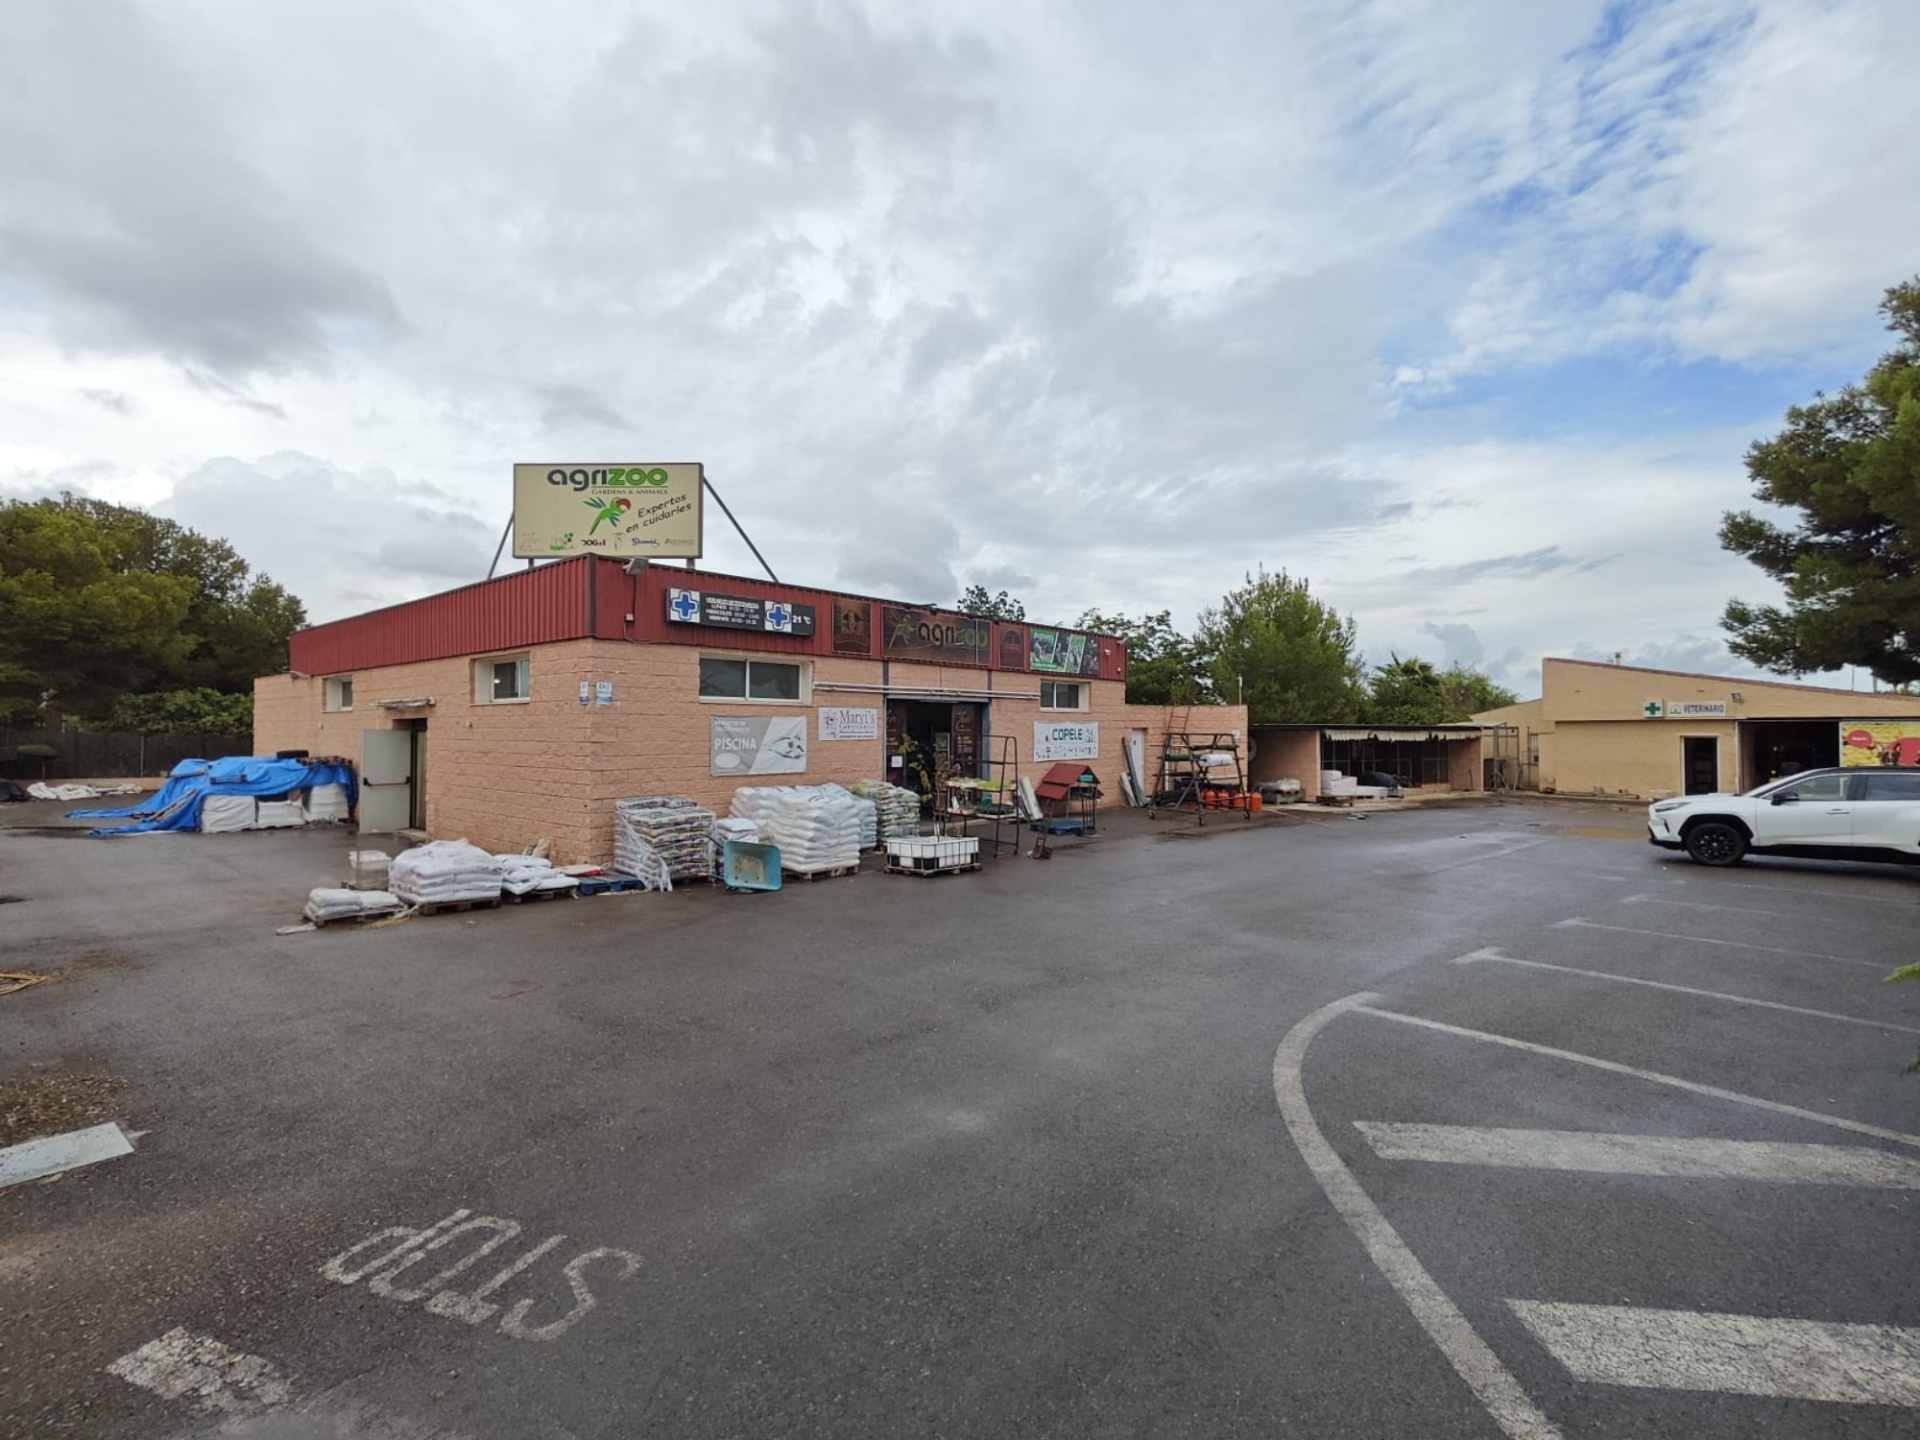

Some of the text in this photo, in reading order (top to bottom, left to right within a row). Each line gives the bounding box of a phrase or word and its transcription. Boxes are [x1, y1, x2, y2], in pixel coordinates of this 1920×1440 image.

[547, 468, 668, 491] agrizoo
[638, 494, 687, 518] Expertos
[625, 503, 692, 533] en cuidarles
[792, 615, 802, 623] 21
[1683, 704, 1724, 713] VETERINARIO
[840, 710, 876, 724] Marvi's
[1052, 728, 1083, 741] COPELE
[714, 738, 757, 750] PISCINA
